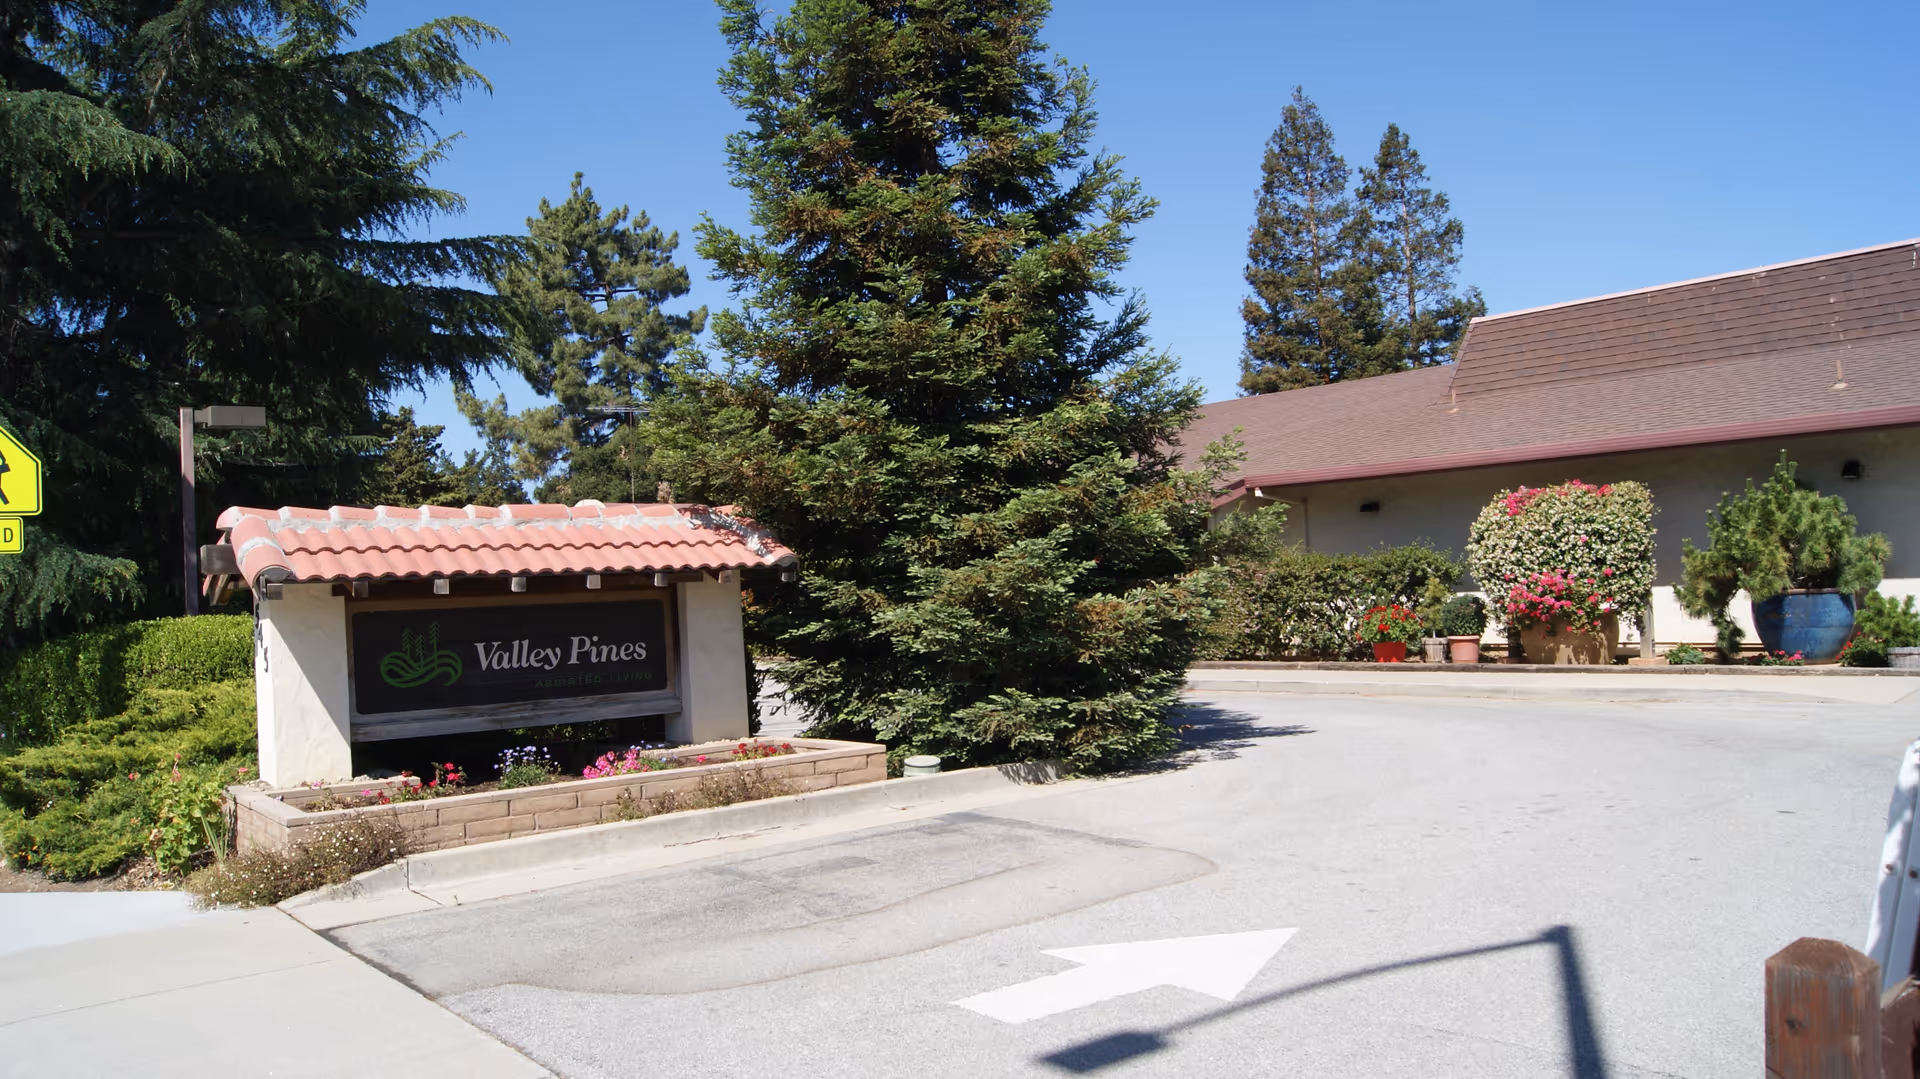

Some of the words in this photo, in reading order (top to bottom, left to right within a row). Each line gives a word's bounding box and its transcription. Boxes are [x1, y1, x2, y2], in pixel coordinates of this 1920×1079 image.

[473, 639, 562, 671] Valley
[567, 635, 647, 664] Pines
[534, 673, 602, 688] ASSISTED
[609, 672, 653, 682] LIVING
